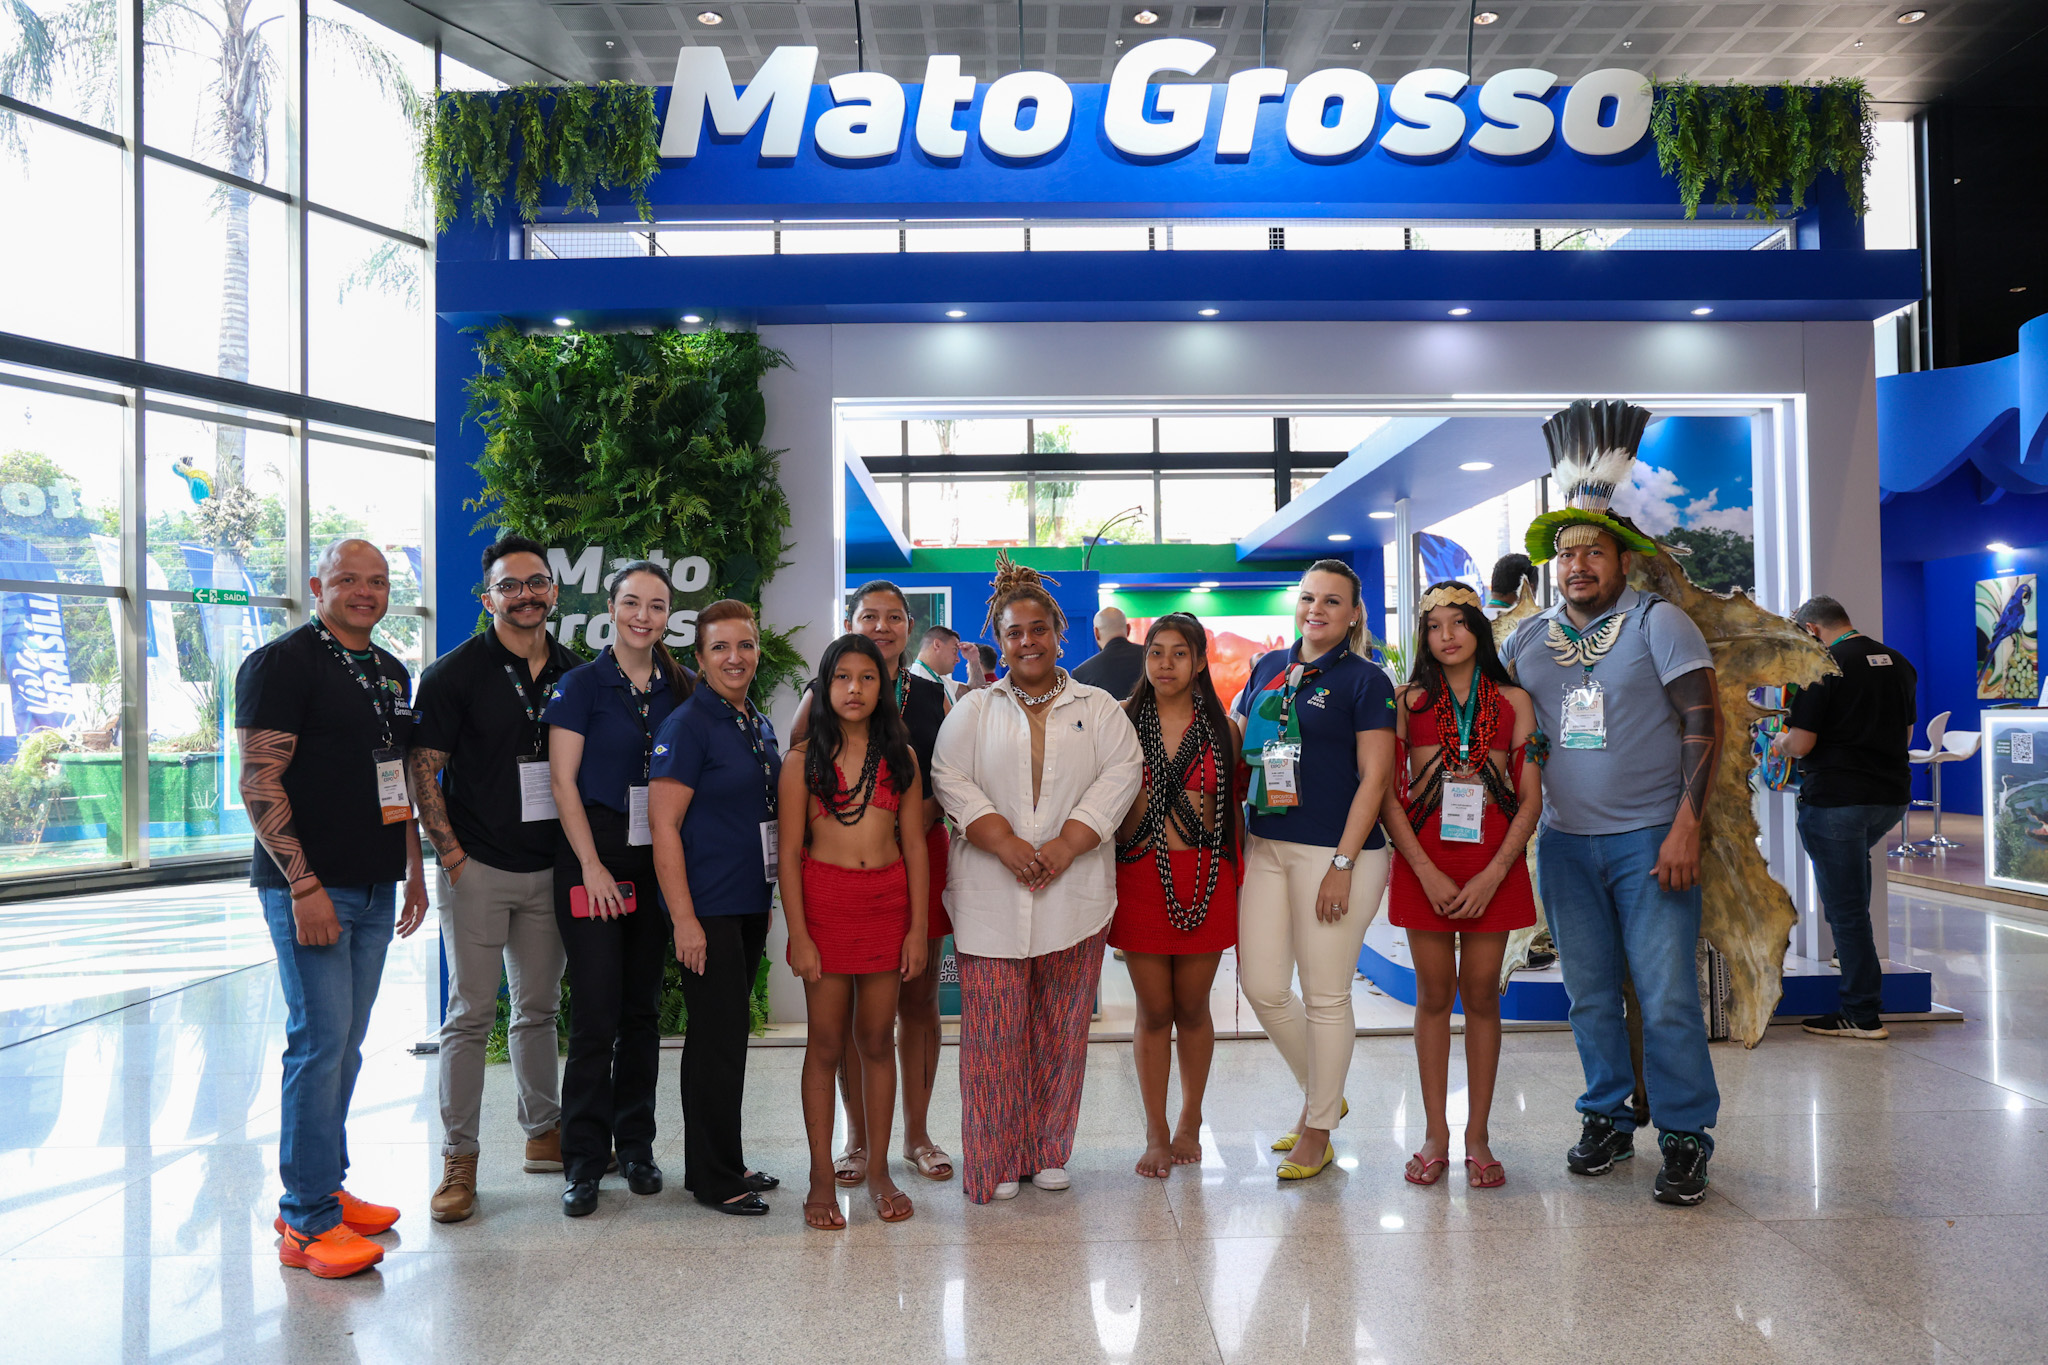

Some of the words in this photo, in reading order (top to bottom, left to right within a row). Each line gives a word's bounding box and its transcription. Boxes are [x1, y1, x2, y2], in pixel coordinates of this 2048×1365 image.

[660, 45, 1073, 159] Mato
[1103, 37, 1652, 157] Grosso
[223, 592, 247, 602] SAÍDA
[1307, 699, 1326, 709] Grosso
[942, 960, 957, 970] Ma
